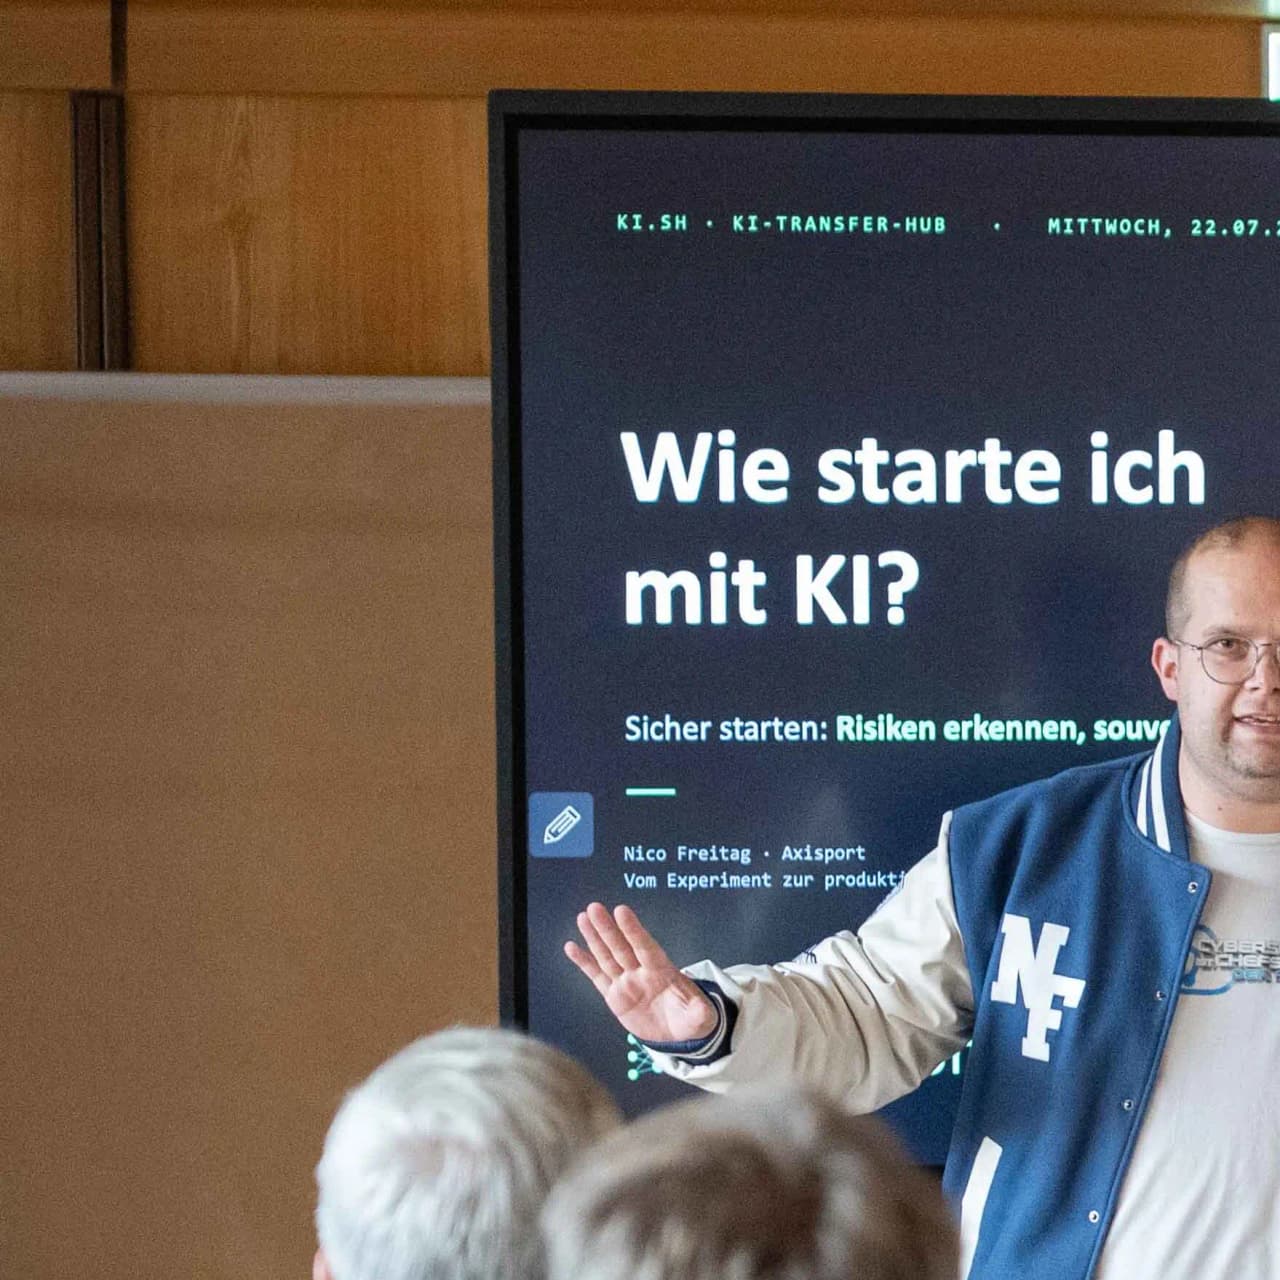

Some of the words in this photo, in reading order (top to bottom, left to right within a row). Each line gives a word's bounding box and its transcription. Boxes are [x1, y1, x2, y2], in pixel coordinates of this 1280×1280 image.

[617, 214, 687, 231] KI.SH
[732, 215, 947, 233] KI-TRANSFER-HUB
[1047, 218, 1173, 238] MITTWOCH,
[620, 429, 790, 503] Wie
[817, 437, 1062, 504] starte
[1090, 429, 1205, 504] ich
[625, 551, 767, 625] mit
[796, 550, 920, 626] KI?
[624, 713, 712, 742] Sicher
[719, 715, 828, 741] starten:
[836, 713, 936, 742] Risiken
[943, 713, 1087, 746] erkennen,
[624, 846, 667, 862] Nico
[677, 846, 752, 864] Freitag
[782, 845, 866, 864] Axisport
[624, 873, 657, 889] Vom
[667, 872, 772, 891] Experiment
[783, 874, 815, 887] zur
